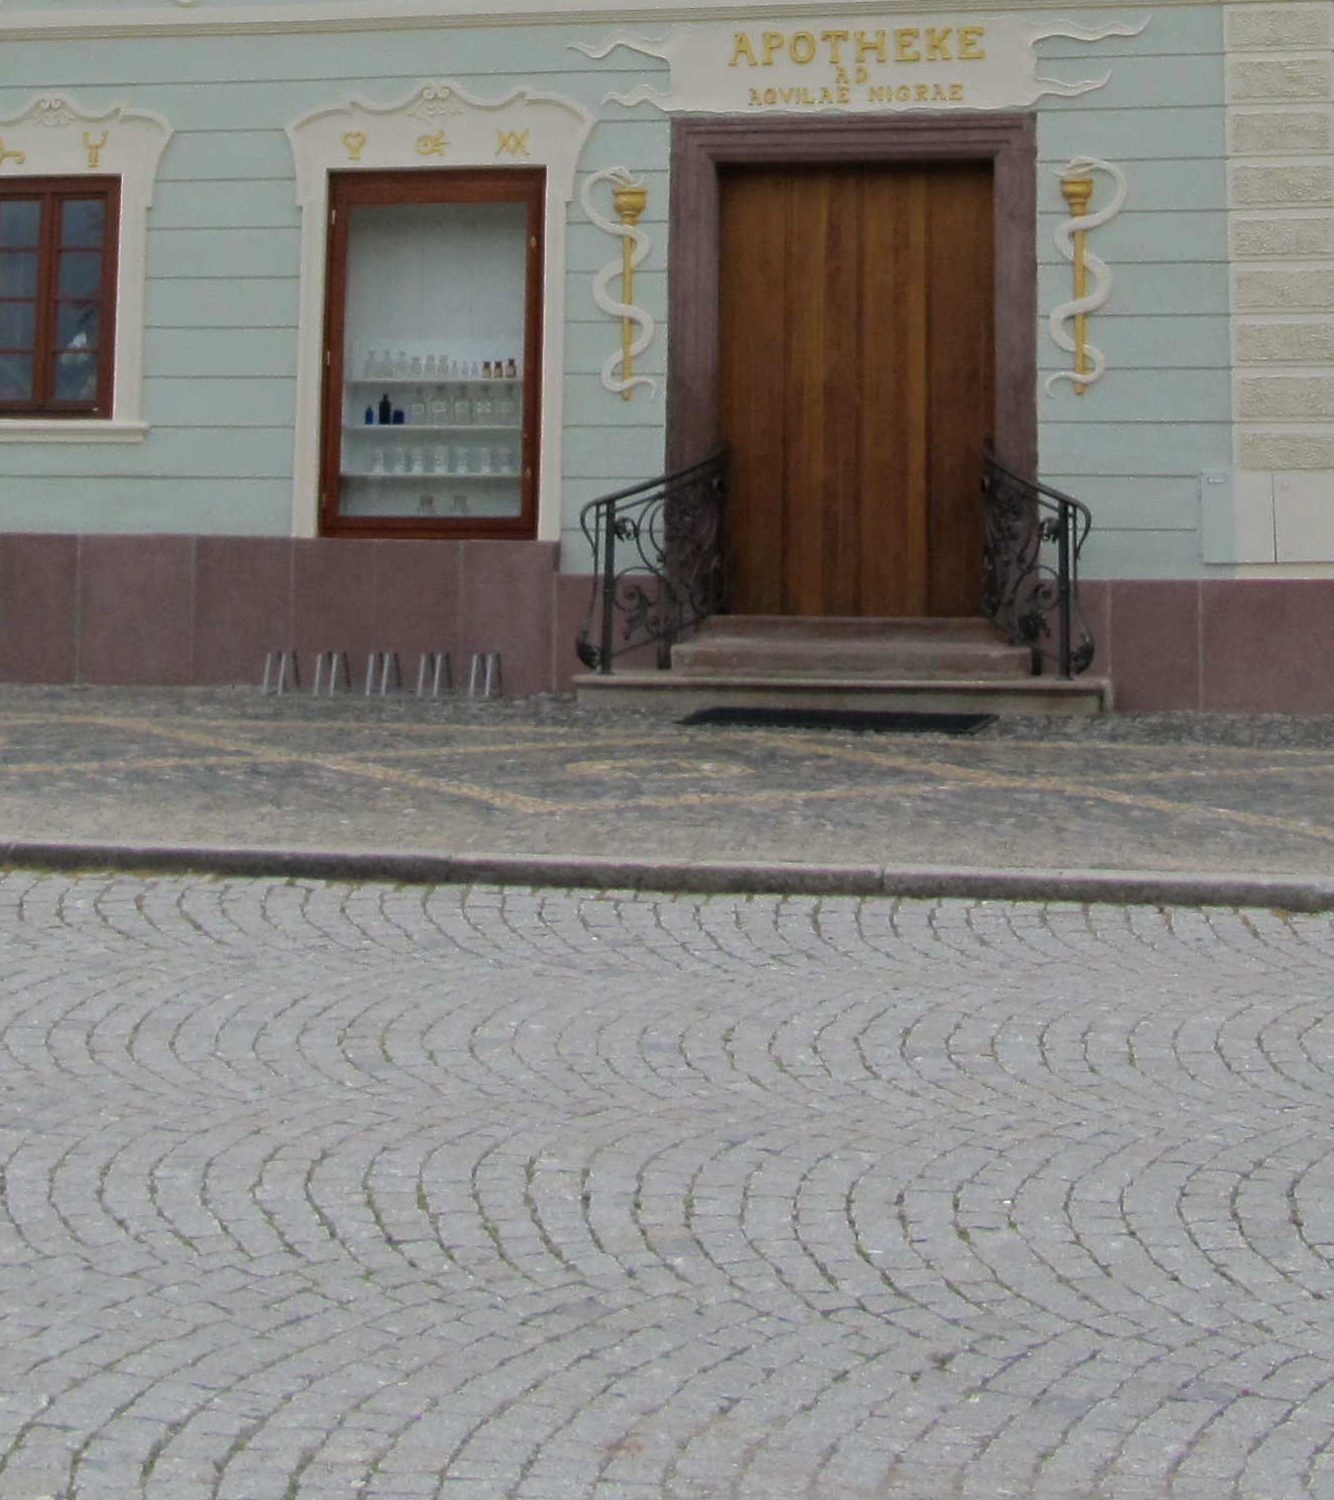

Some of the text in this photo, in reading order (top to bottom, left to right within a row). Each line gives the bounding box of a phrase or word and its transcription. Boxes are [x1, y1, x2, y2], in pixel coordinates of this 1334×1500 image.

[728, 26, 986, 66] APOTHEKE
[835, 65, 868, 84] AD
[748, 82, 964, 106] AQVILAE NIGRAE
